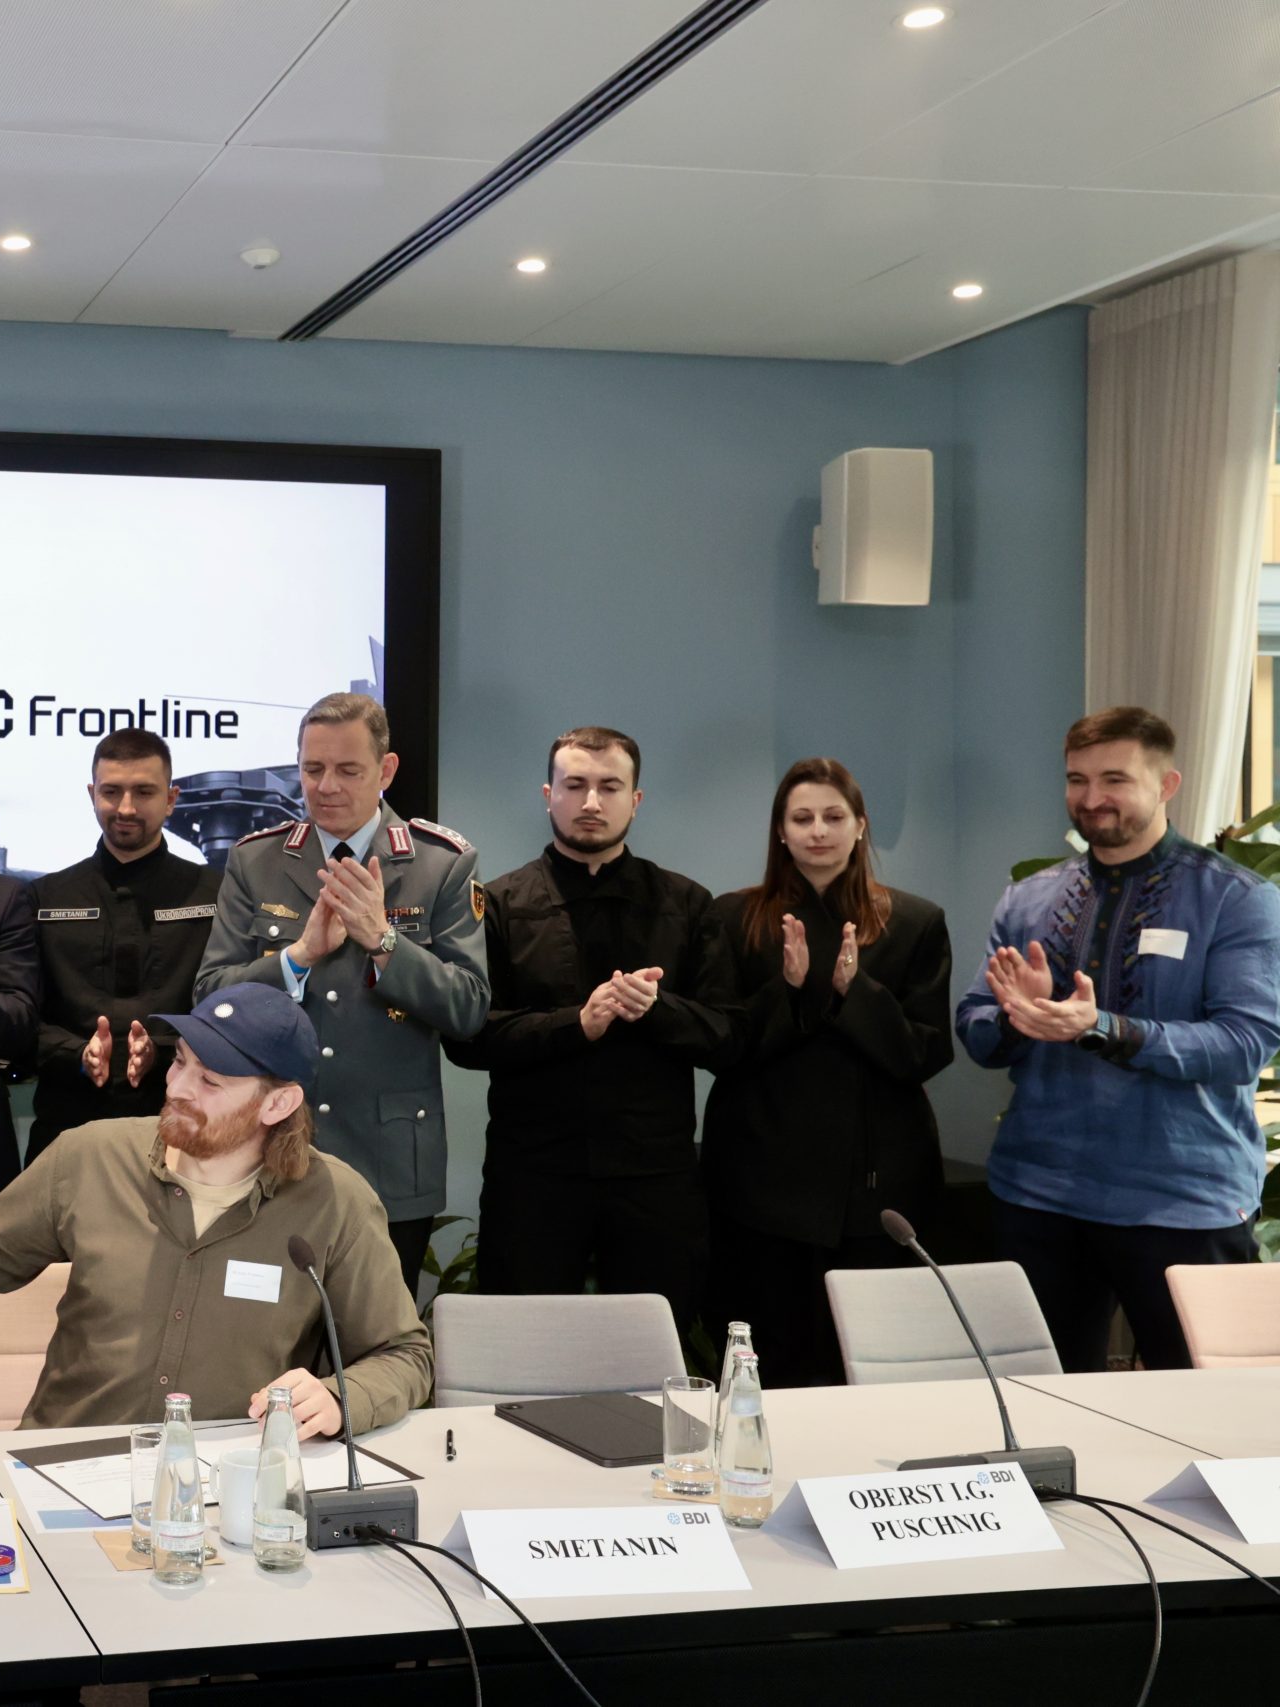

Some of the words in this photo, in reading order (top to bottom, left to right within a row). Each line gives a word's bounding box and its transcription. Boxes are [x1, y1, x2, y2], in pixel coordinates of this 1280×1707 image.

[30, 695, 239, 739] Frontline
[49, 910, 89, 919] SMETANIN
[989, 1469, 1016, 1484] BDI
[848, 1483, 947, 1510] OBERST
[949, 1479, 995, 1502] I.G.
[681, 1511, 711, 1525] BDI
[871, 1511, 1002, 1541] PUSCHNIG
[527, 1536, 680, 1560] SMETANIN
